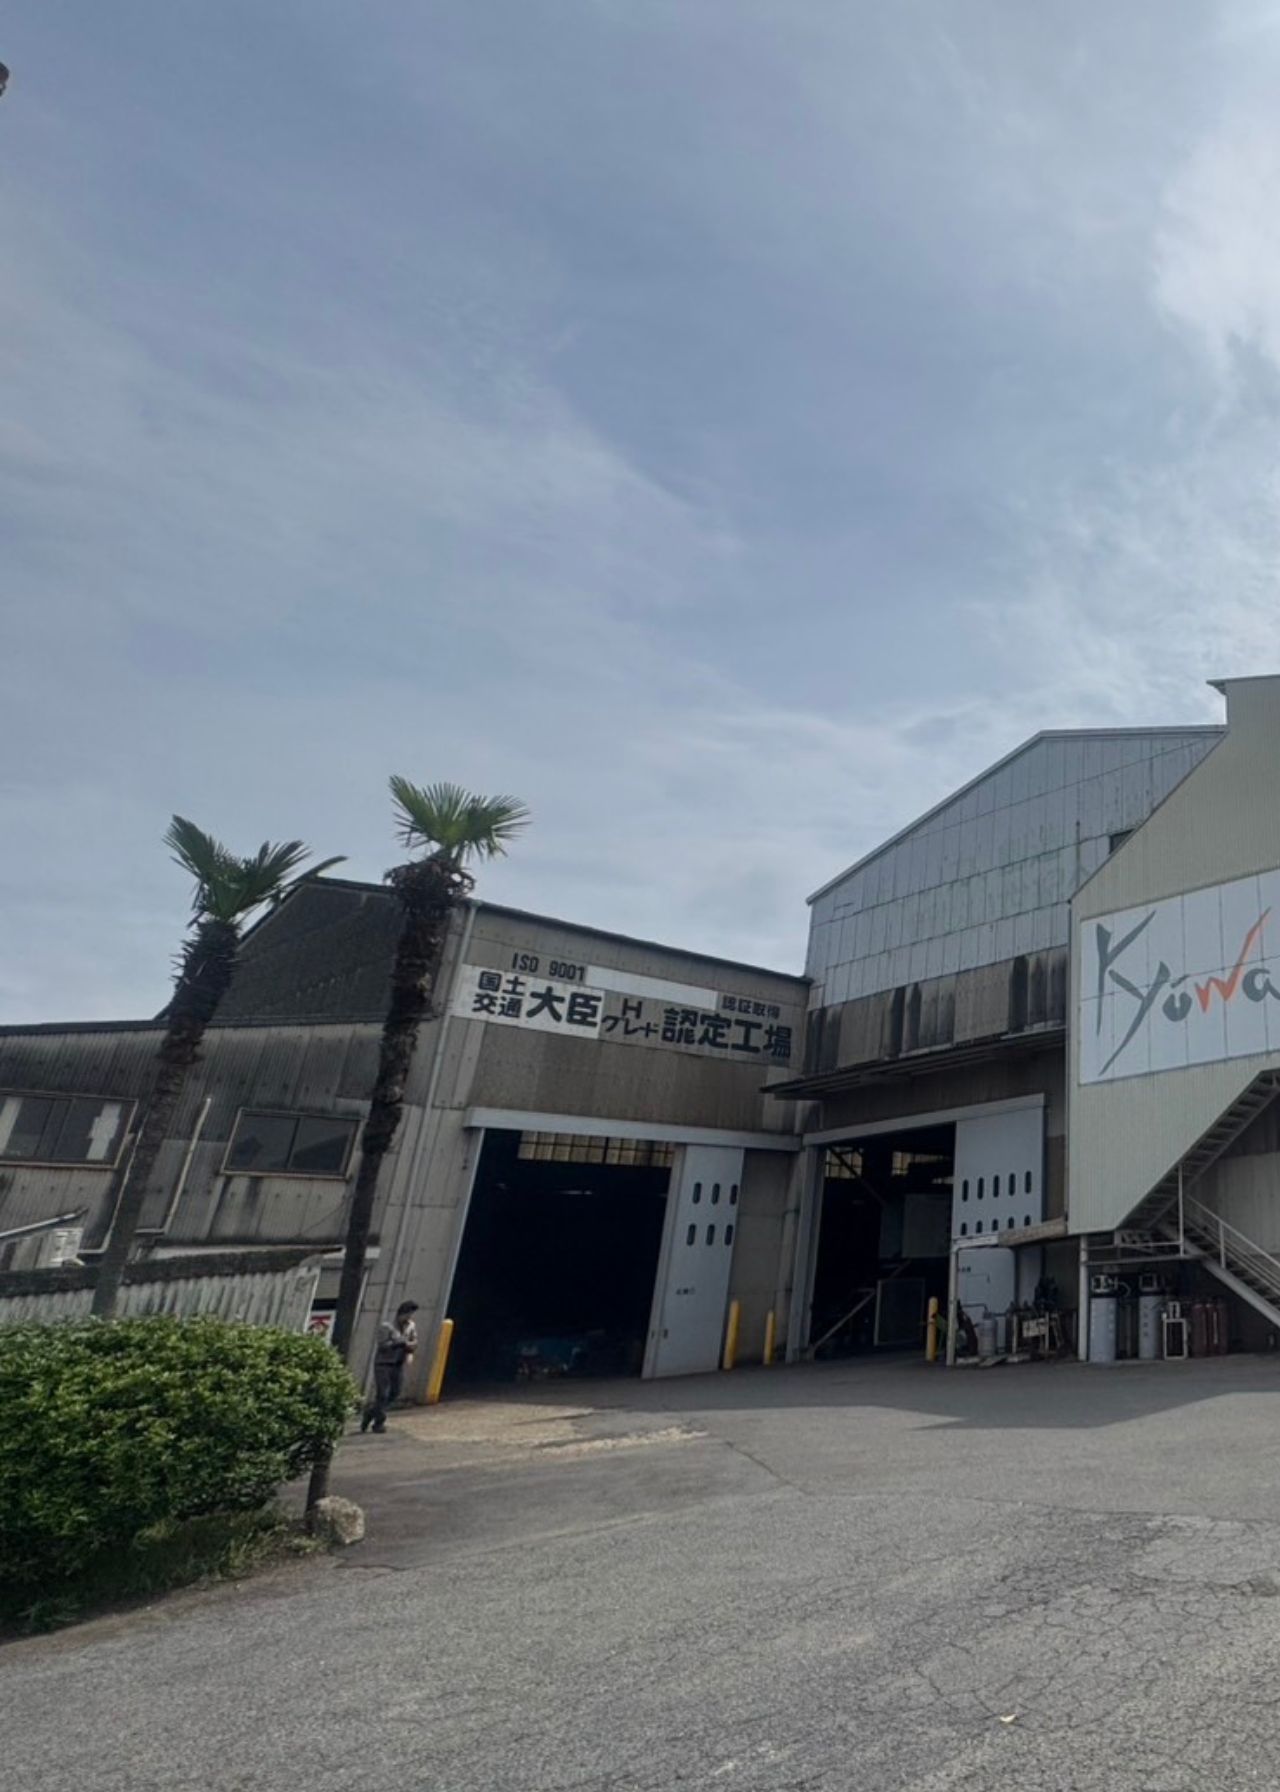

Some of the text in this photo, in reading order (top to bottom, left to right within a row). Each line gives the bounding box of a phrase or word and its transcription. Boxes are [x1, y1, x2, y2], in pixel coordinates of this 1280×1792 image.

[511, 952, 539, 973] ISO
[549, 960, 585, 982] 9001
[478, 970, 526, 996] 国土
[471, 992, 521, 1019] 交通
[526, 986, 602, 1027] 大臣
[622, 998, 643, 1019] H
[661, 1007, 792, 1058] 認定工場
